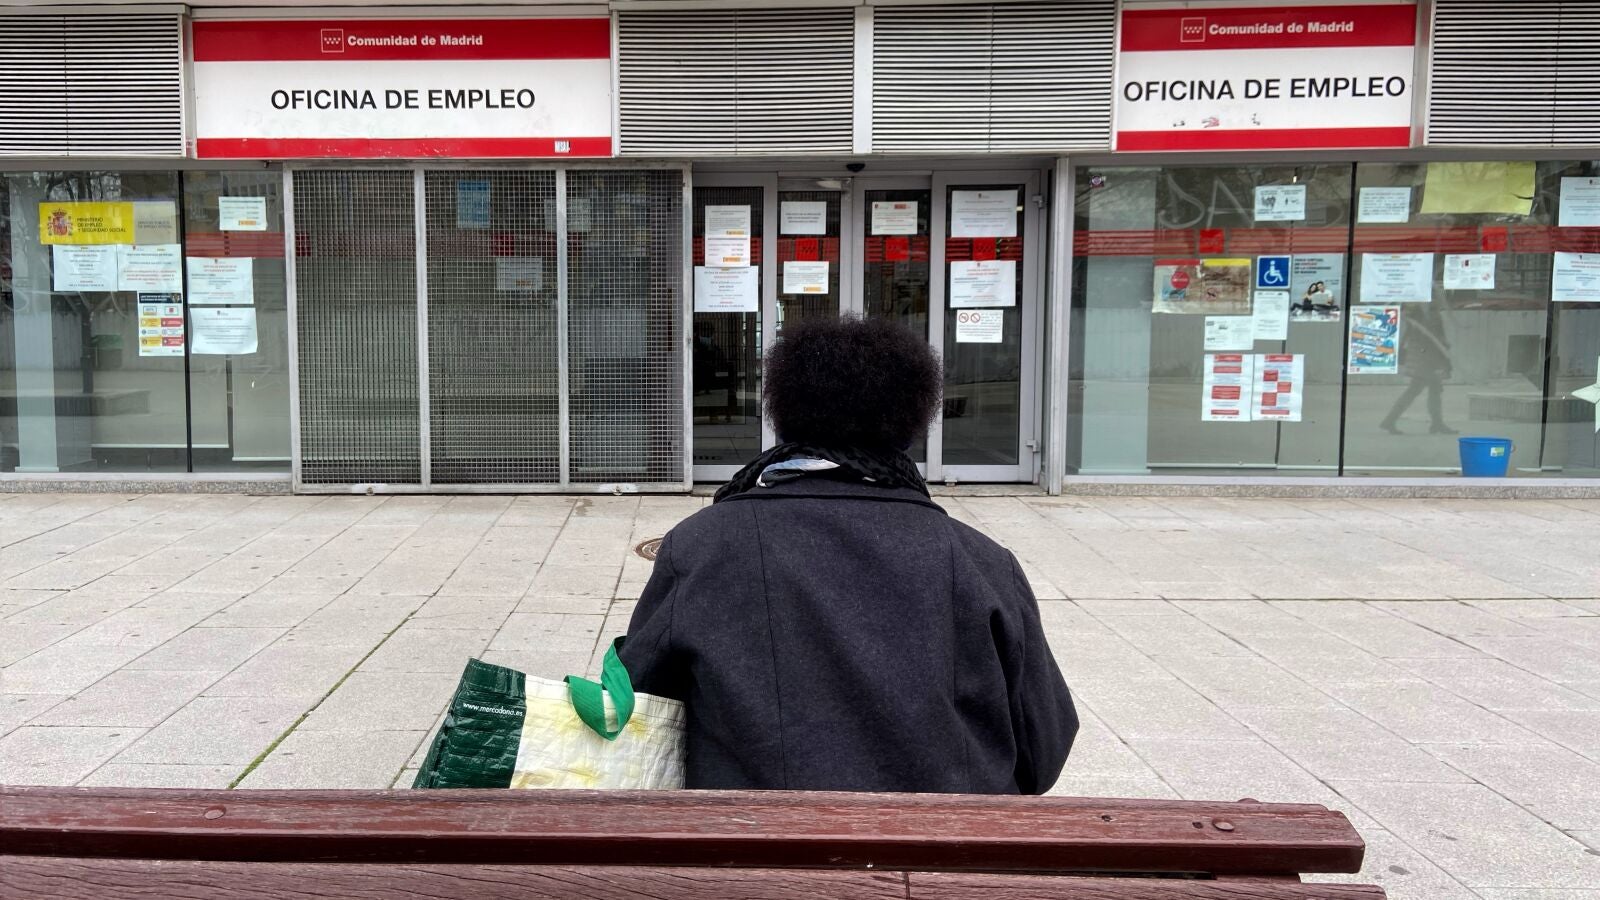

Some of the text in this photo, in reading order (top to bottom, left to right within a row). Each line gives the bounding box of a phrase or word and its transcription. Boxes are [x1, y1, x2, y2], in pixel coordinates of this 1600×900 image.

[1208, 21, 1355, 36] Comunidad de Madrid
[347, 34, 483, 46] Comunidad de Madrid
[1123, 76, 1406, 102] OFICINA DE EMPLEO
[271, 89, 536, 110] OFICINA DE EMPLEO
[462, 702, 523, 717] www.mercadona.es
